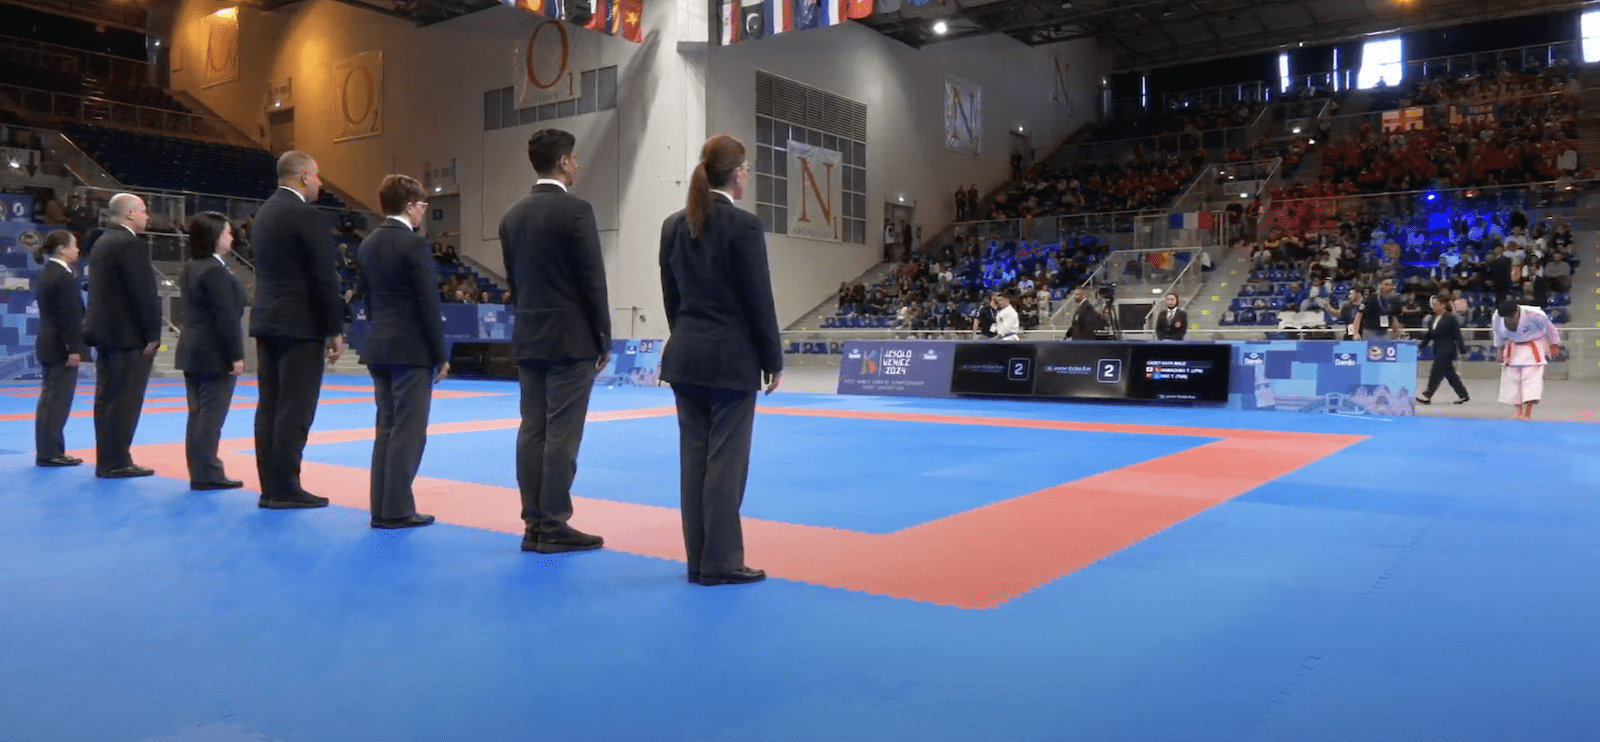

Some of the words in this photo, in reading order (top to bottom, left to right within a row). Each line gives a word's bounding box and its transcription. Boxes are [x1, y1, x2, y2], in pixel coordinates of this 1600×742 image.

[883, 350, 912, 358] JESOLO
[882, 359, 911, 367] VENICE
[884, 367, 906, 375] 2024
[1014, 363, 1024, 376] 2
[1104, 364, 1115, 377] 2
